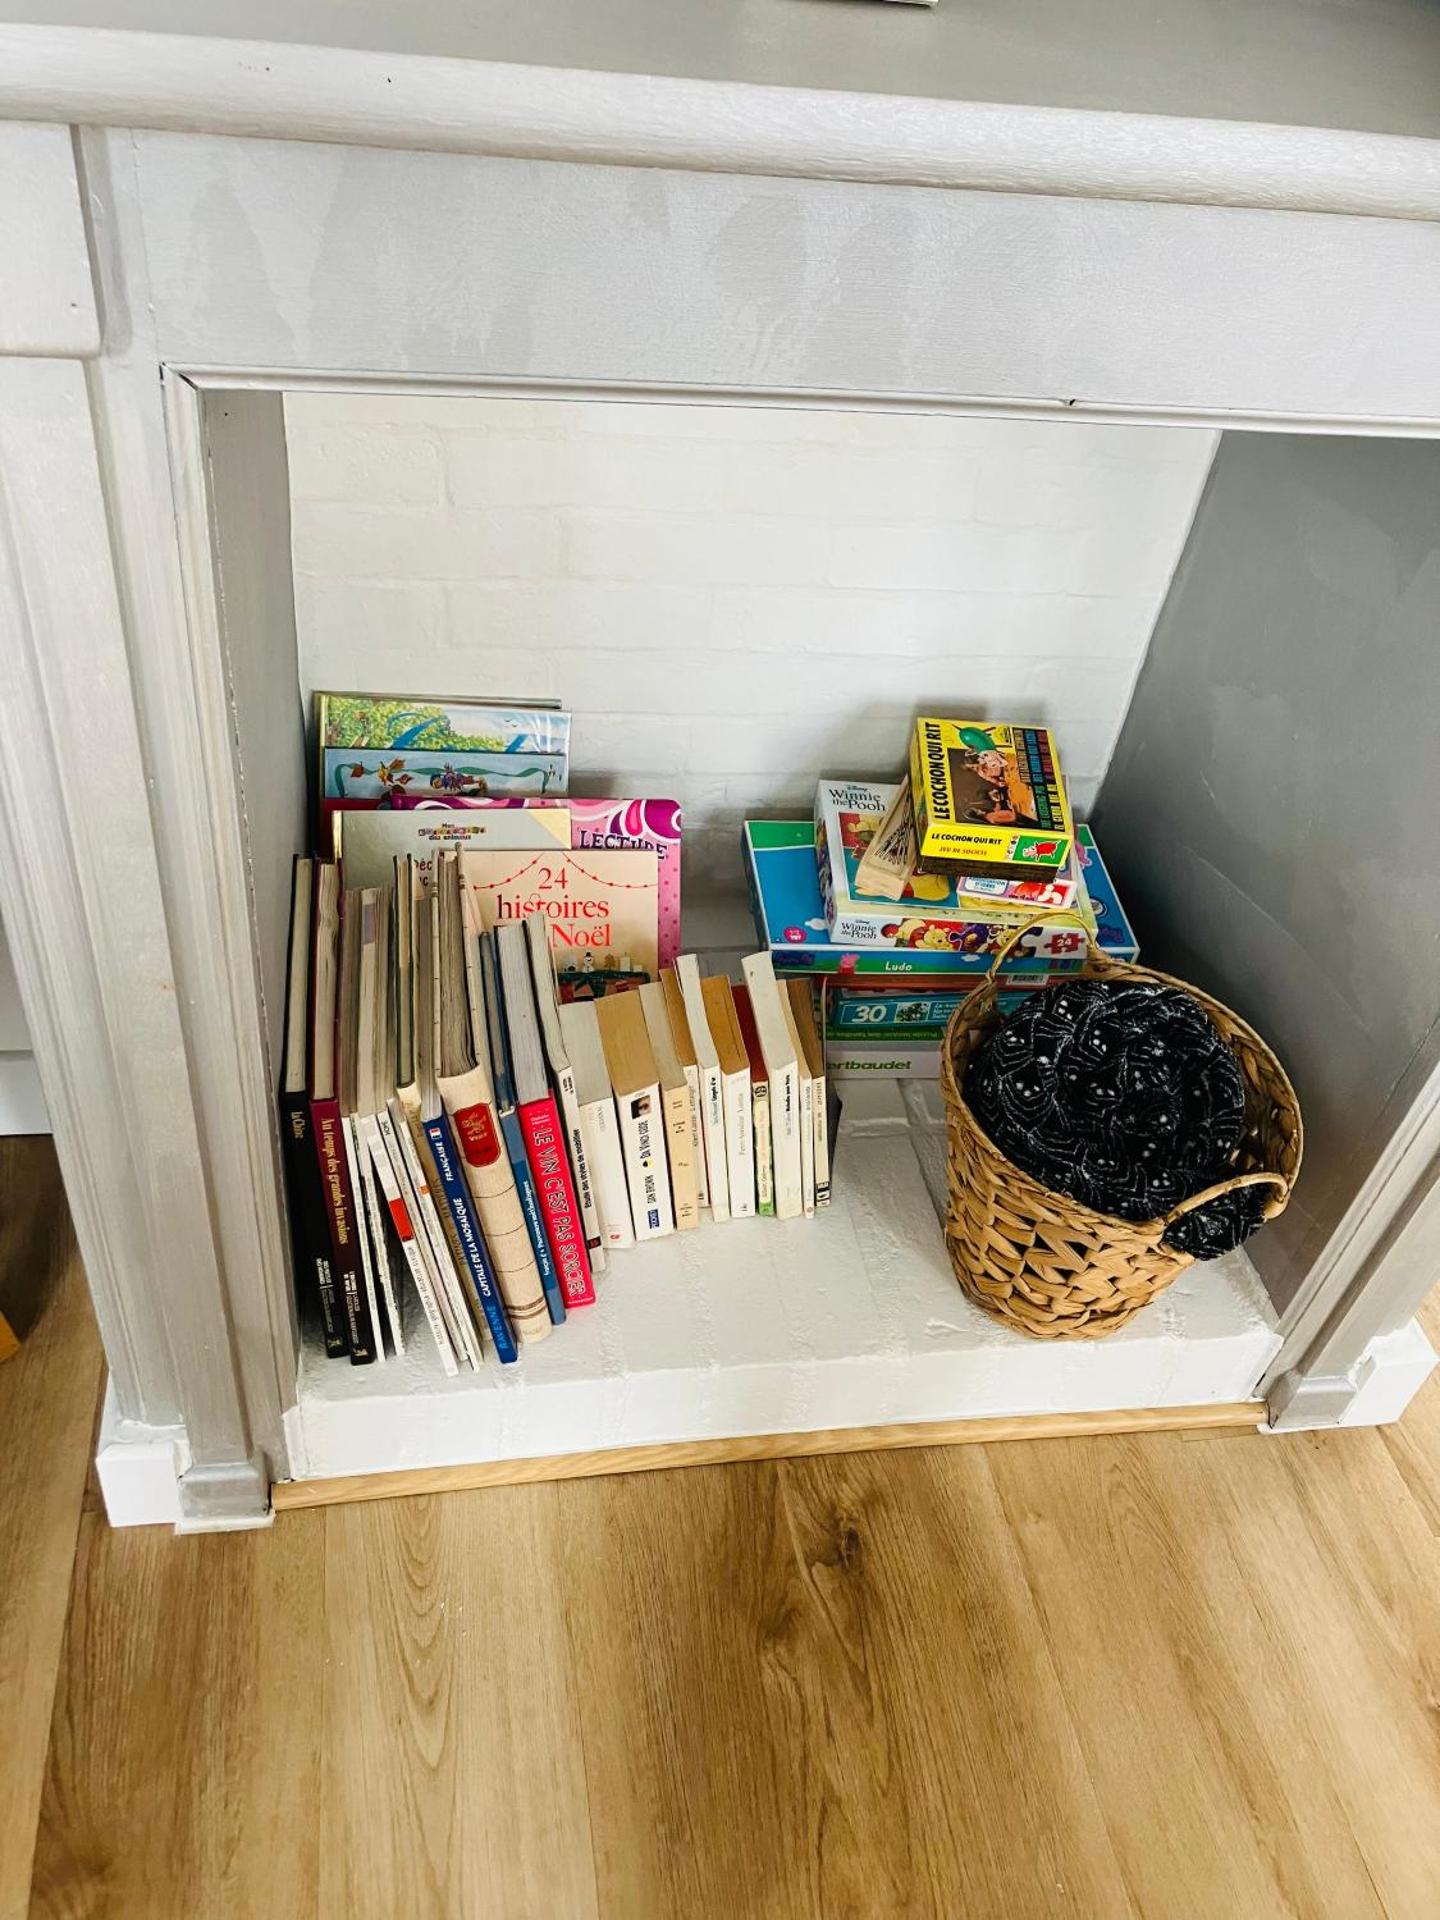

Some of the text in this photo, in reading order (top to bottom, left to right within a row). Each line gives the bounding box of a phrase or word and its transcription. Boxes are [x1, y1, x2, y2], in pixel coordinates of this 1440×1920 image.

[925, 722, 951, 820] LE COCHON QUI RIT
[829, 788, 881, 801] Winnie
[847, 799, 886, 812] Pooh
[941, 834, 973, 843] COCHON
[973, 836, 988, 845] QUI
[988, 838, 1003, 846] RIT
[538, 867, 568, 889] 24
[496, 894, 610, 920] histoires
[551, 924, 611, 947] Noël
[841, 922, 877, 932] Winnie
[851, 930, 878, 939] Pooh
[1056, 937, 1072, 947] 24
[885, 960, 913, 971] Ludo
[851, 1005, 887, 1023] 30
[532, 1128, 554, 1145] LE
[435, 1140, 454, 1182] FRANÇAISE
[536, 1146, 560, 1174] VIN
[319, 1117, 352, 1244] Au temps des grandes invasions
[543, 1176, 569, 1215] C'EST
[551, 1215, 574, 1242] PAS
[451, 1195, 491, 1297] CAPITALE DE LA MOSAÏQUE
[558, 1243, 586, 1296] SORCIER
